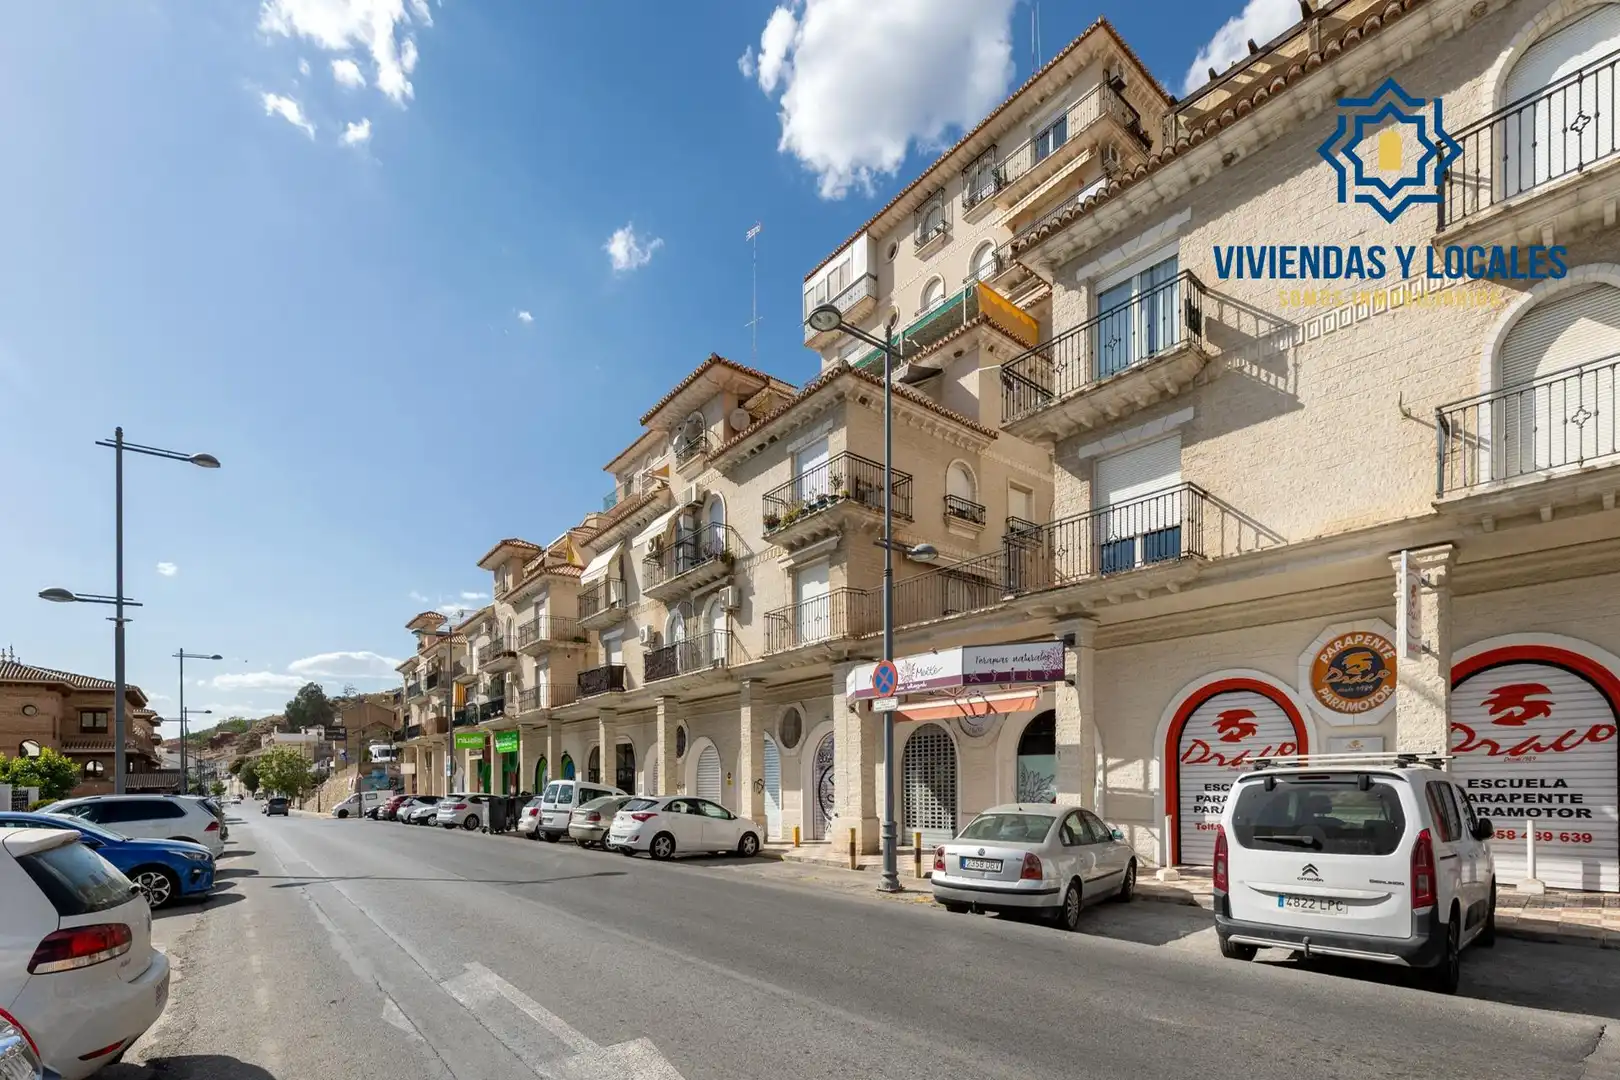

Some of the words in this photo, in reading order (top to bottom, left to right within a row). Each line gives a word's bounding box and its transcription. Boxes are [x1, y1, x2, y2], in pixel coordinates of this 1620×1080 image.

[1320, 634, 1396, 664] PARAPENTE
[1322, 667, 1392, 684] Draco
[1318, 685, 1394, 711] PARAMOTOR
[1450, 722, 1617, 757] Draco
[1467, 779, 1568, 789] ESCUELA
[1466, 793, 1584, 804] ARAPENTE
[1476, 807, 1593, 819] RAMOTOR
[1490, 829, 1517, 840] 58
[1559, 832, 1593, 844] 639
[1286, 896, 1316, 910] 4822
[1319, 900, 1343, 912] LPC
